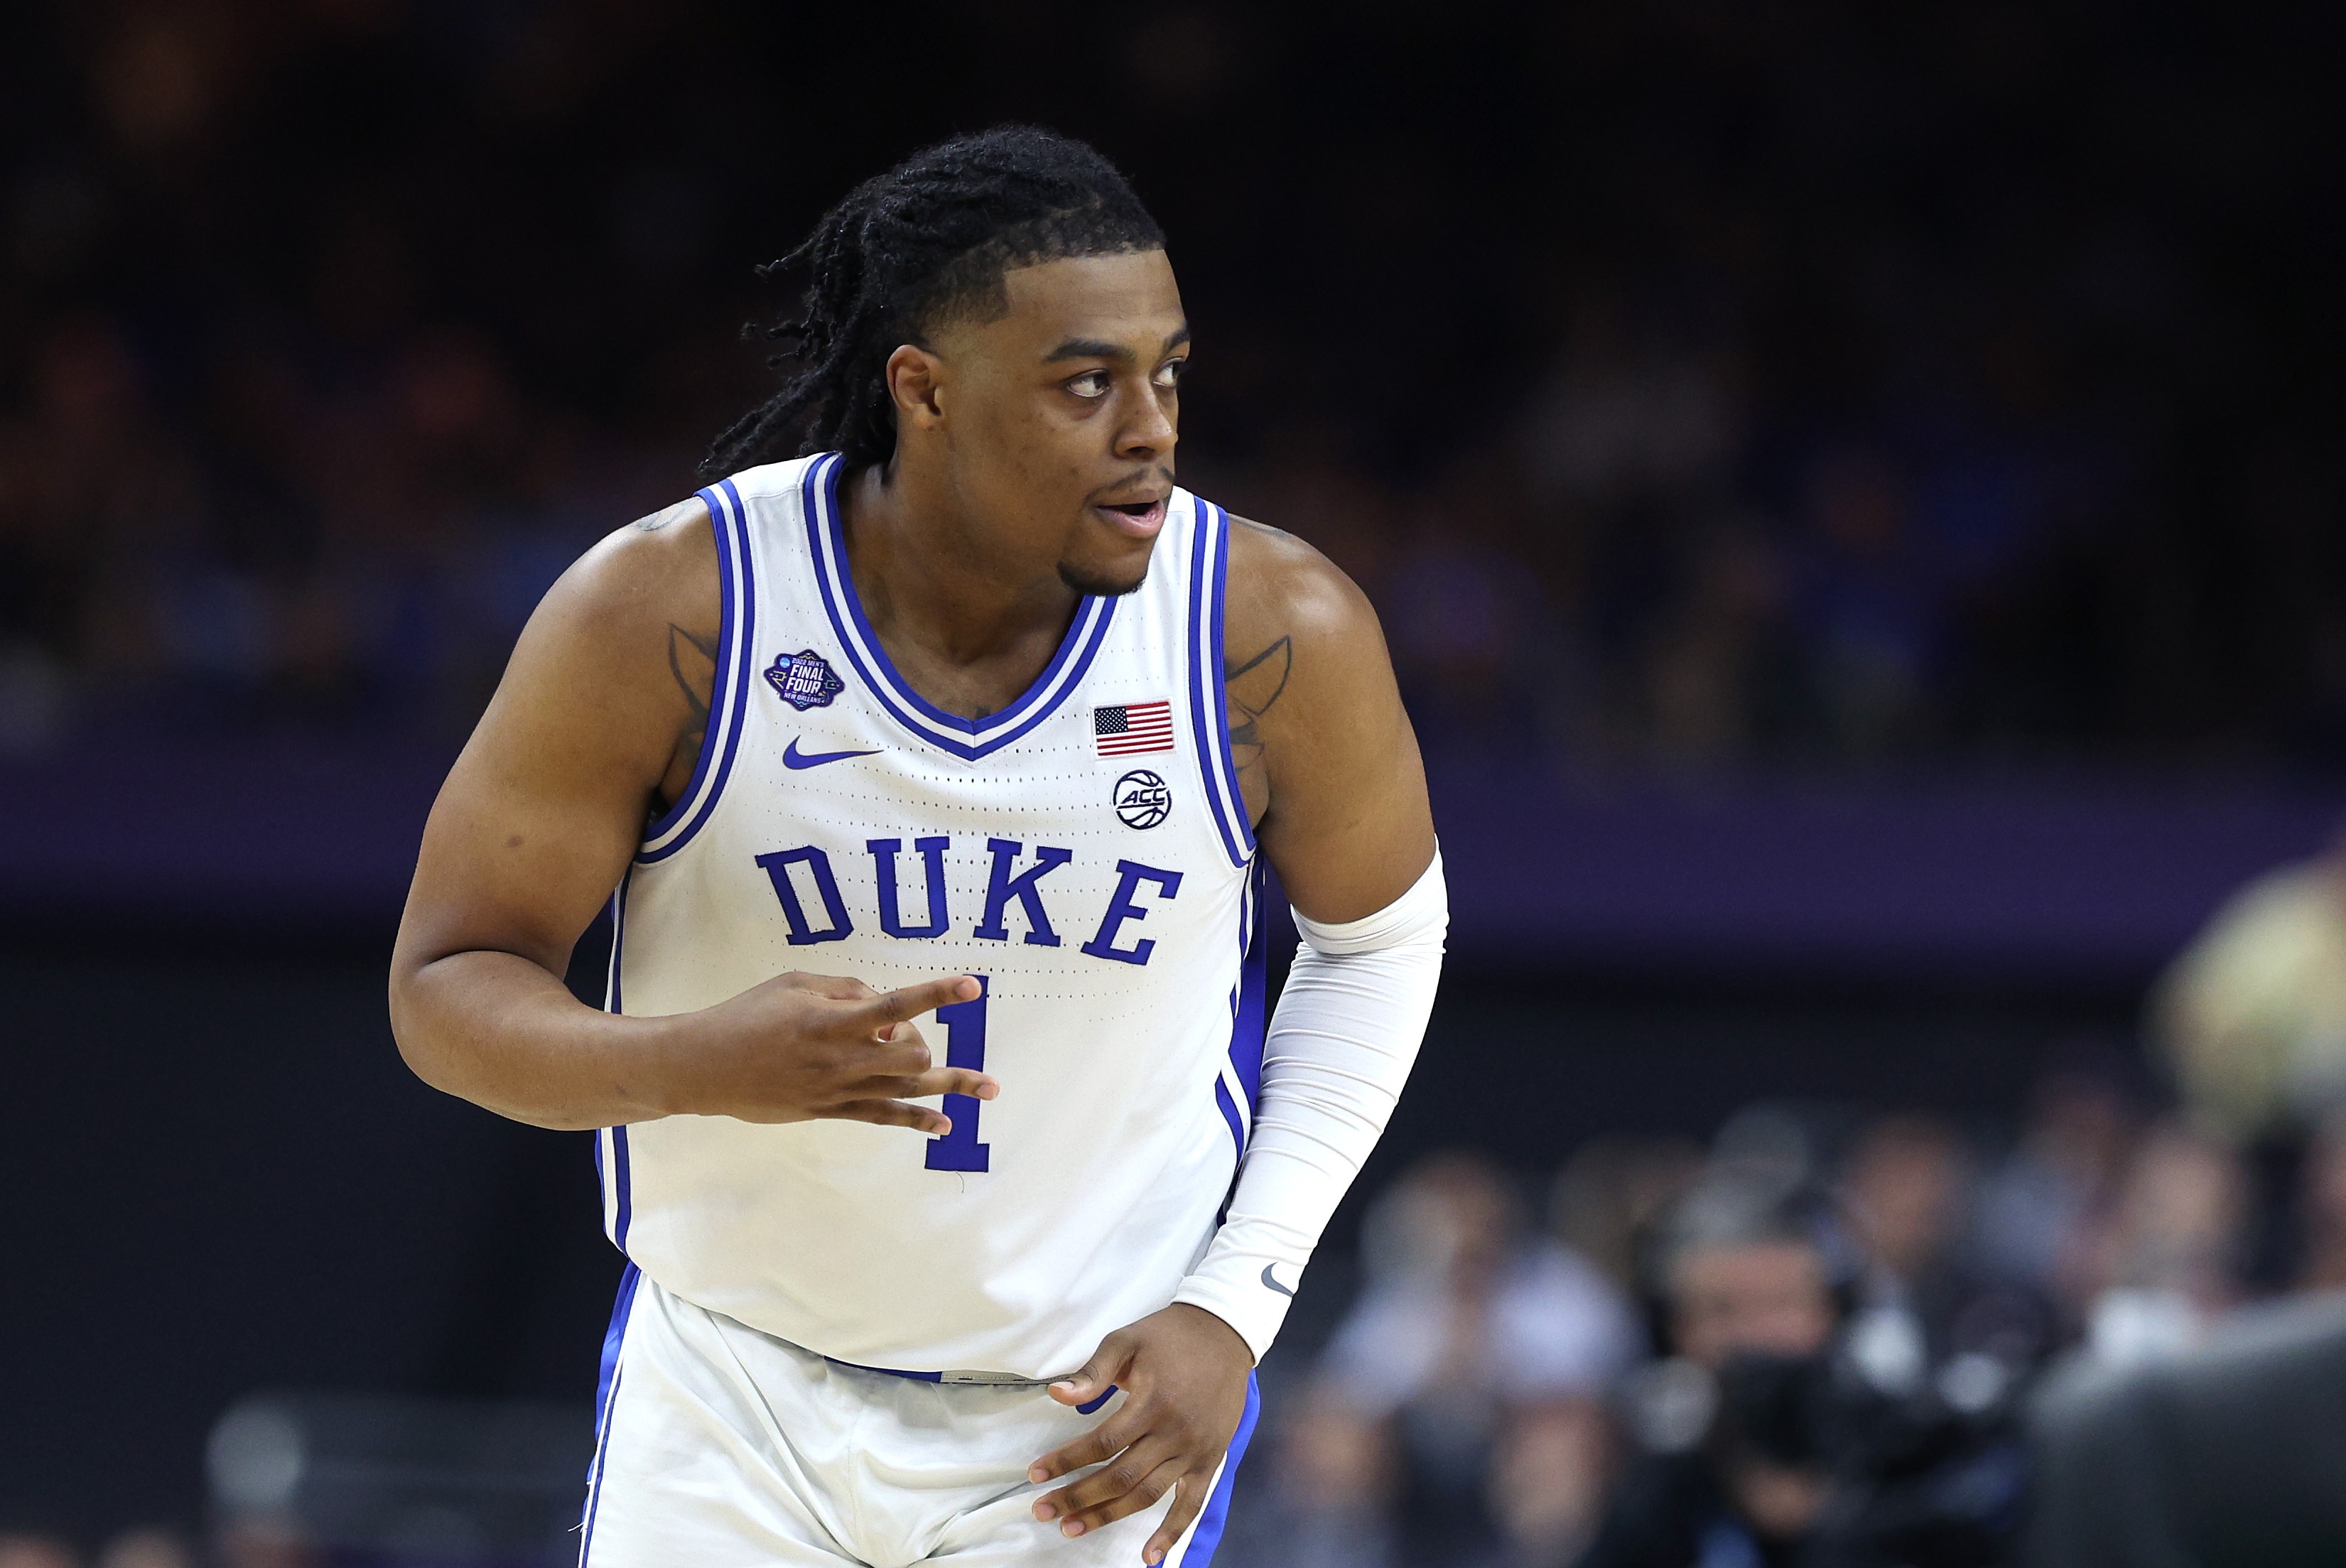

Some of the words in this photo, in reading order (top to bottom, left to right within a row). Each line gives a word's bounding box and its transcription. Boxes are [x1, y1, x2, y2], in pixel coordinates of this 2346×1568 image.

[790, 664, 824, 681] FINAL
[786, 677, 821, 693] FOUR
[1120, 787, 1167, 804] ACC
[755, 836, 1184, 966] DUKE
[924, 974, 990, 1172] 1
